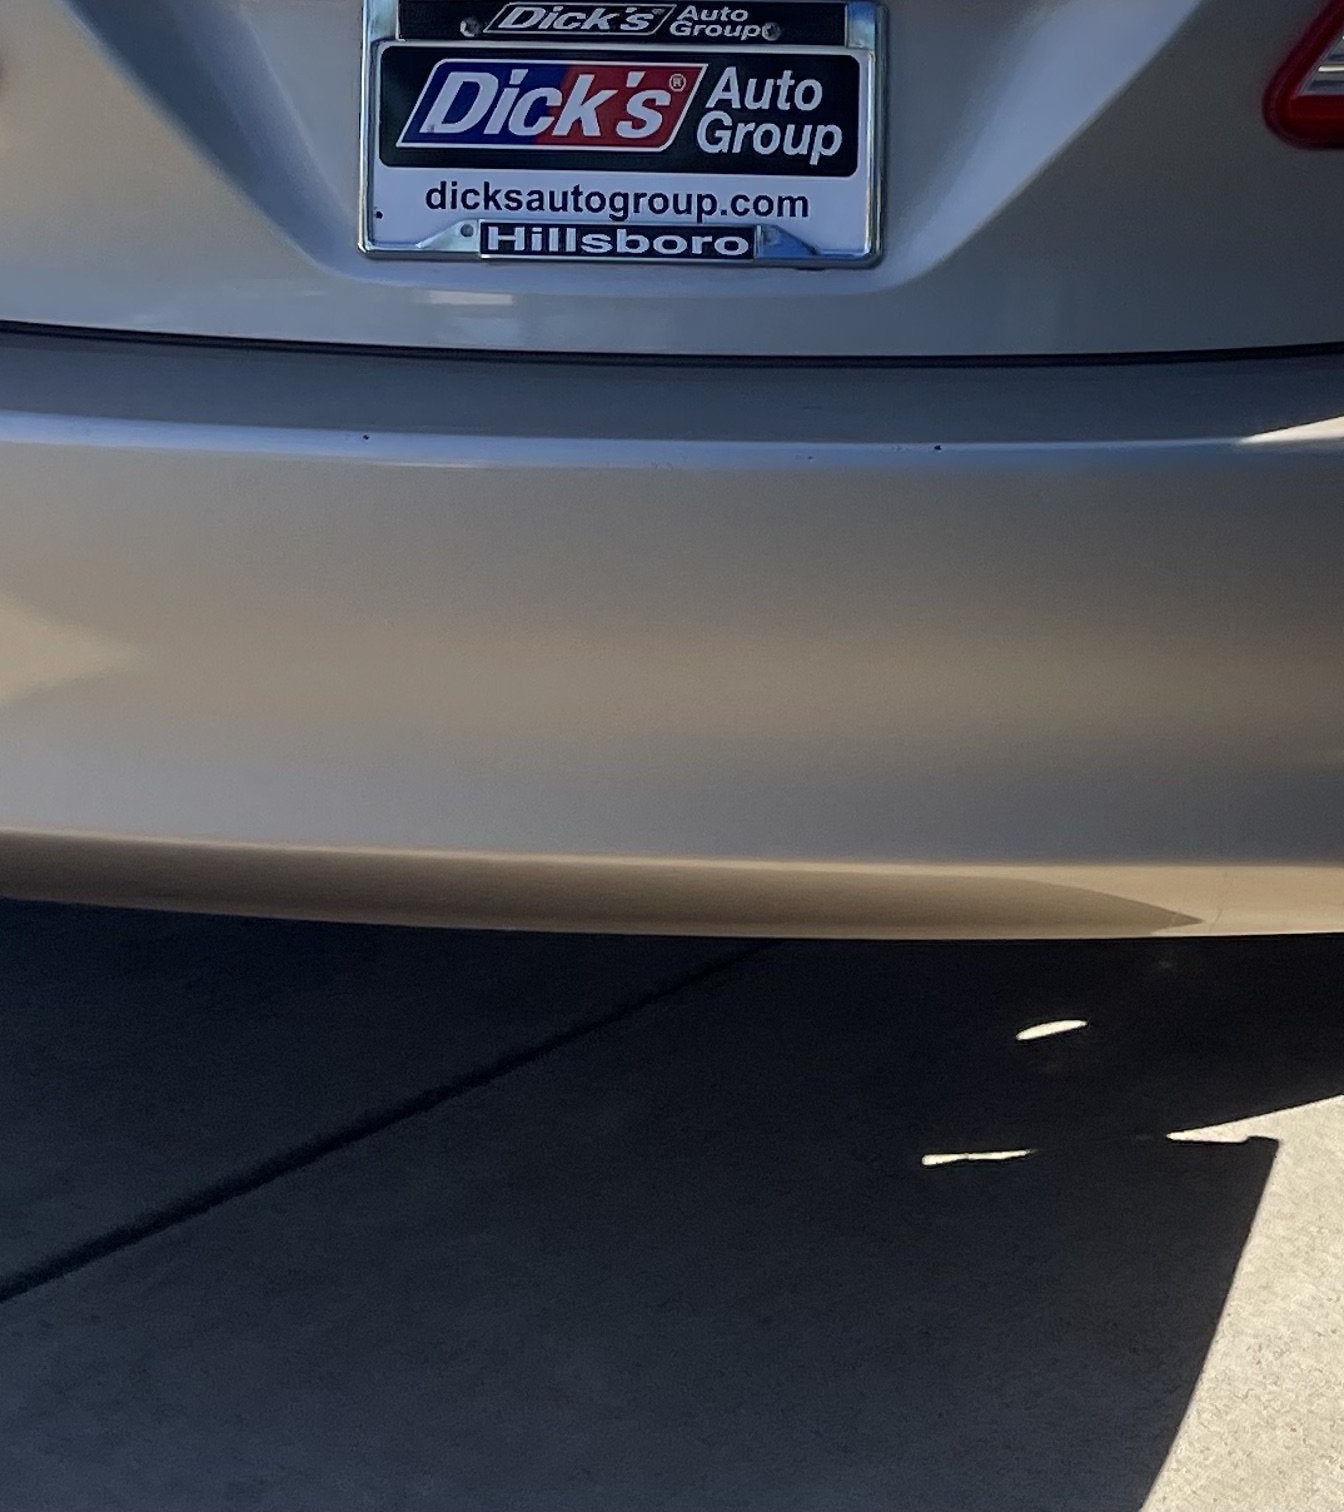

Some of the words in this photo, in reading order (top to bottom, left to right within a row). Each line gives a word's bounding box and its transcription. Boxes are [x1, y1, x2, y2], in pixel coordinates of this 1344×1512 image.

[669, 19, 763, 40] Group
[676, 4, 749, 22] Auto
[705, 66, 824, 112] Auto
[697, 110, 843, 166] Group
[425, 180, 810, 221] dicksautogroup.com
[486, 225, 750, 257] Hillsboro
